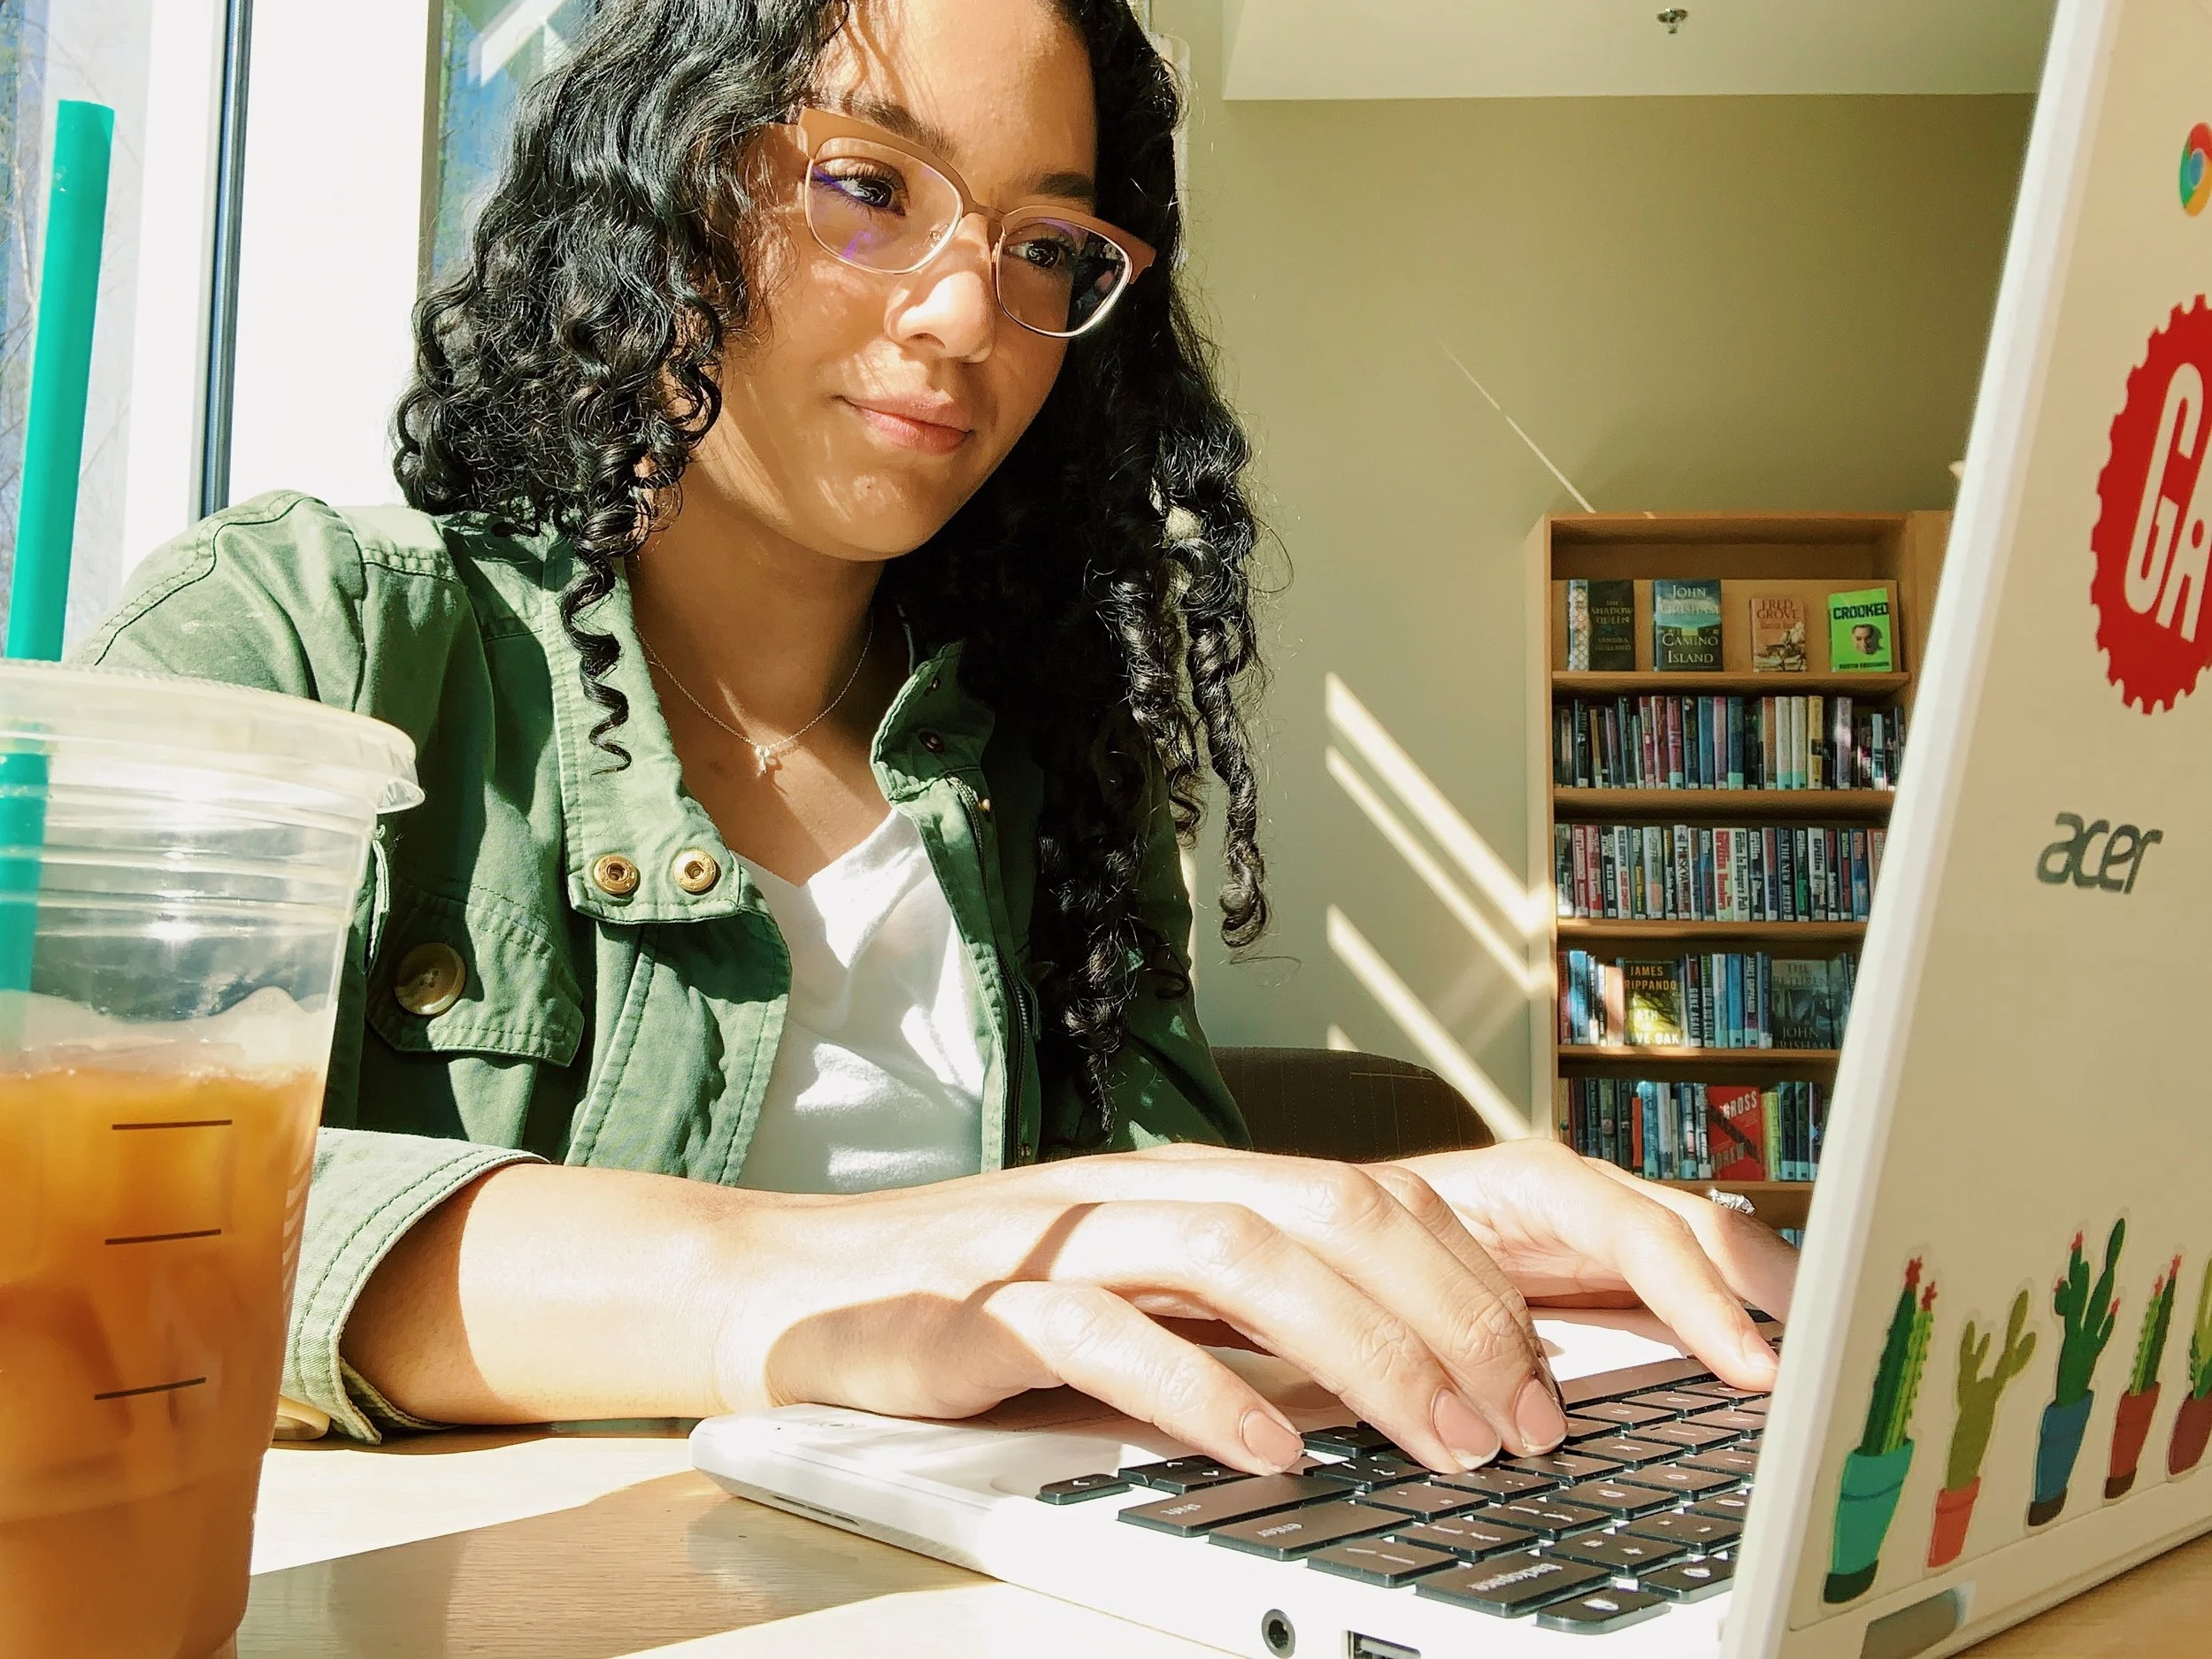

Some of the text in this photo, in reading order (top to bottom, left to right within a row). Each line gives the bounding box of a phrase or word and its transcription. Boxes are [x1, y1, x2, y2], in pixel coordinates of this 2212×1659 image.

[1672, 585, 1707, 598] JOHN
[1832, 603, 1890, 620] CROOKED
[1662, 633, 1718, 647] CAMINO
[1667, 650, 1714, 664] ISLAND
[2036, 812, 2162, 895] acer
[1630, 965, 1663, 976] JAMES
[1625, 979, 1678, 990] RIPPANDO
